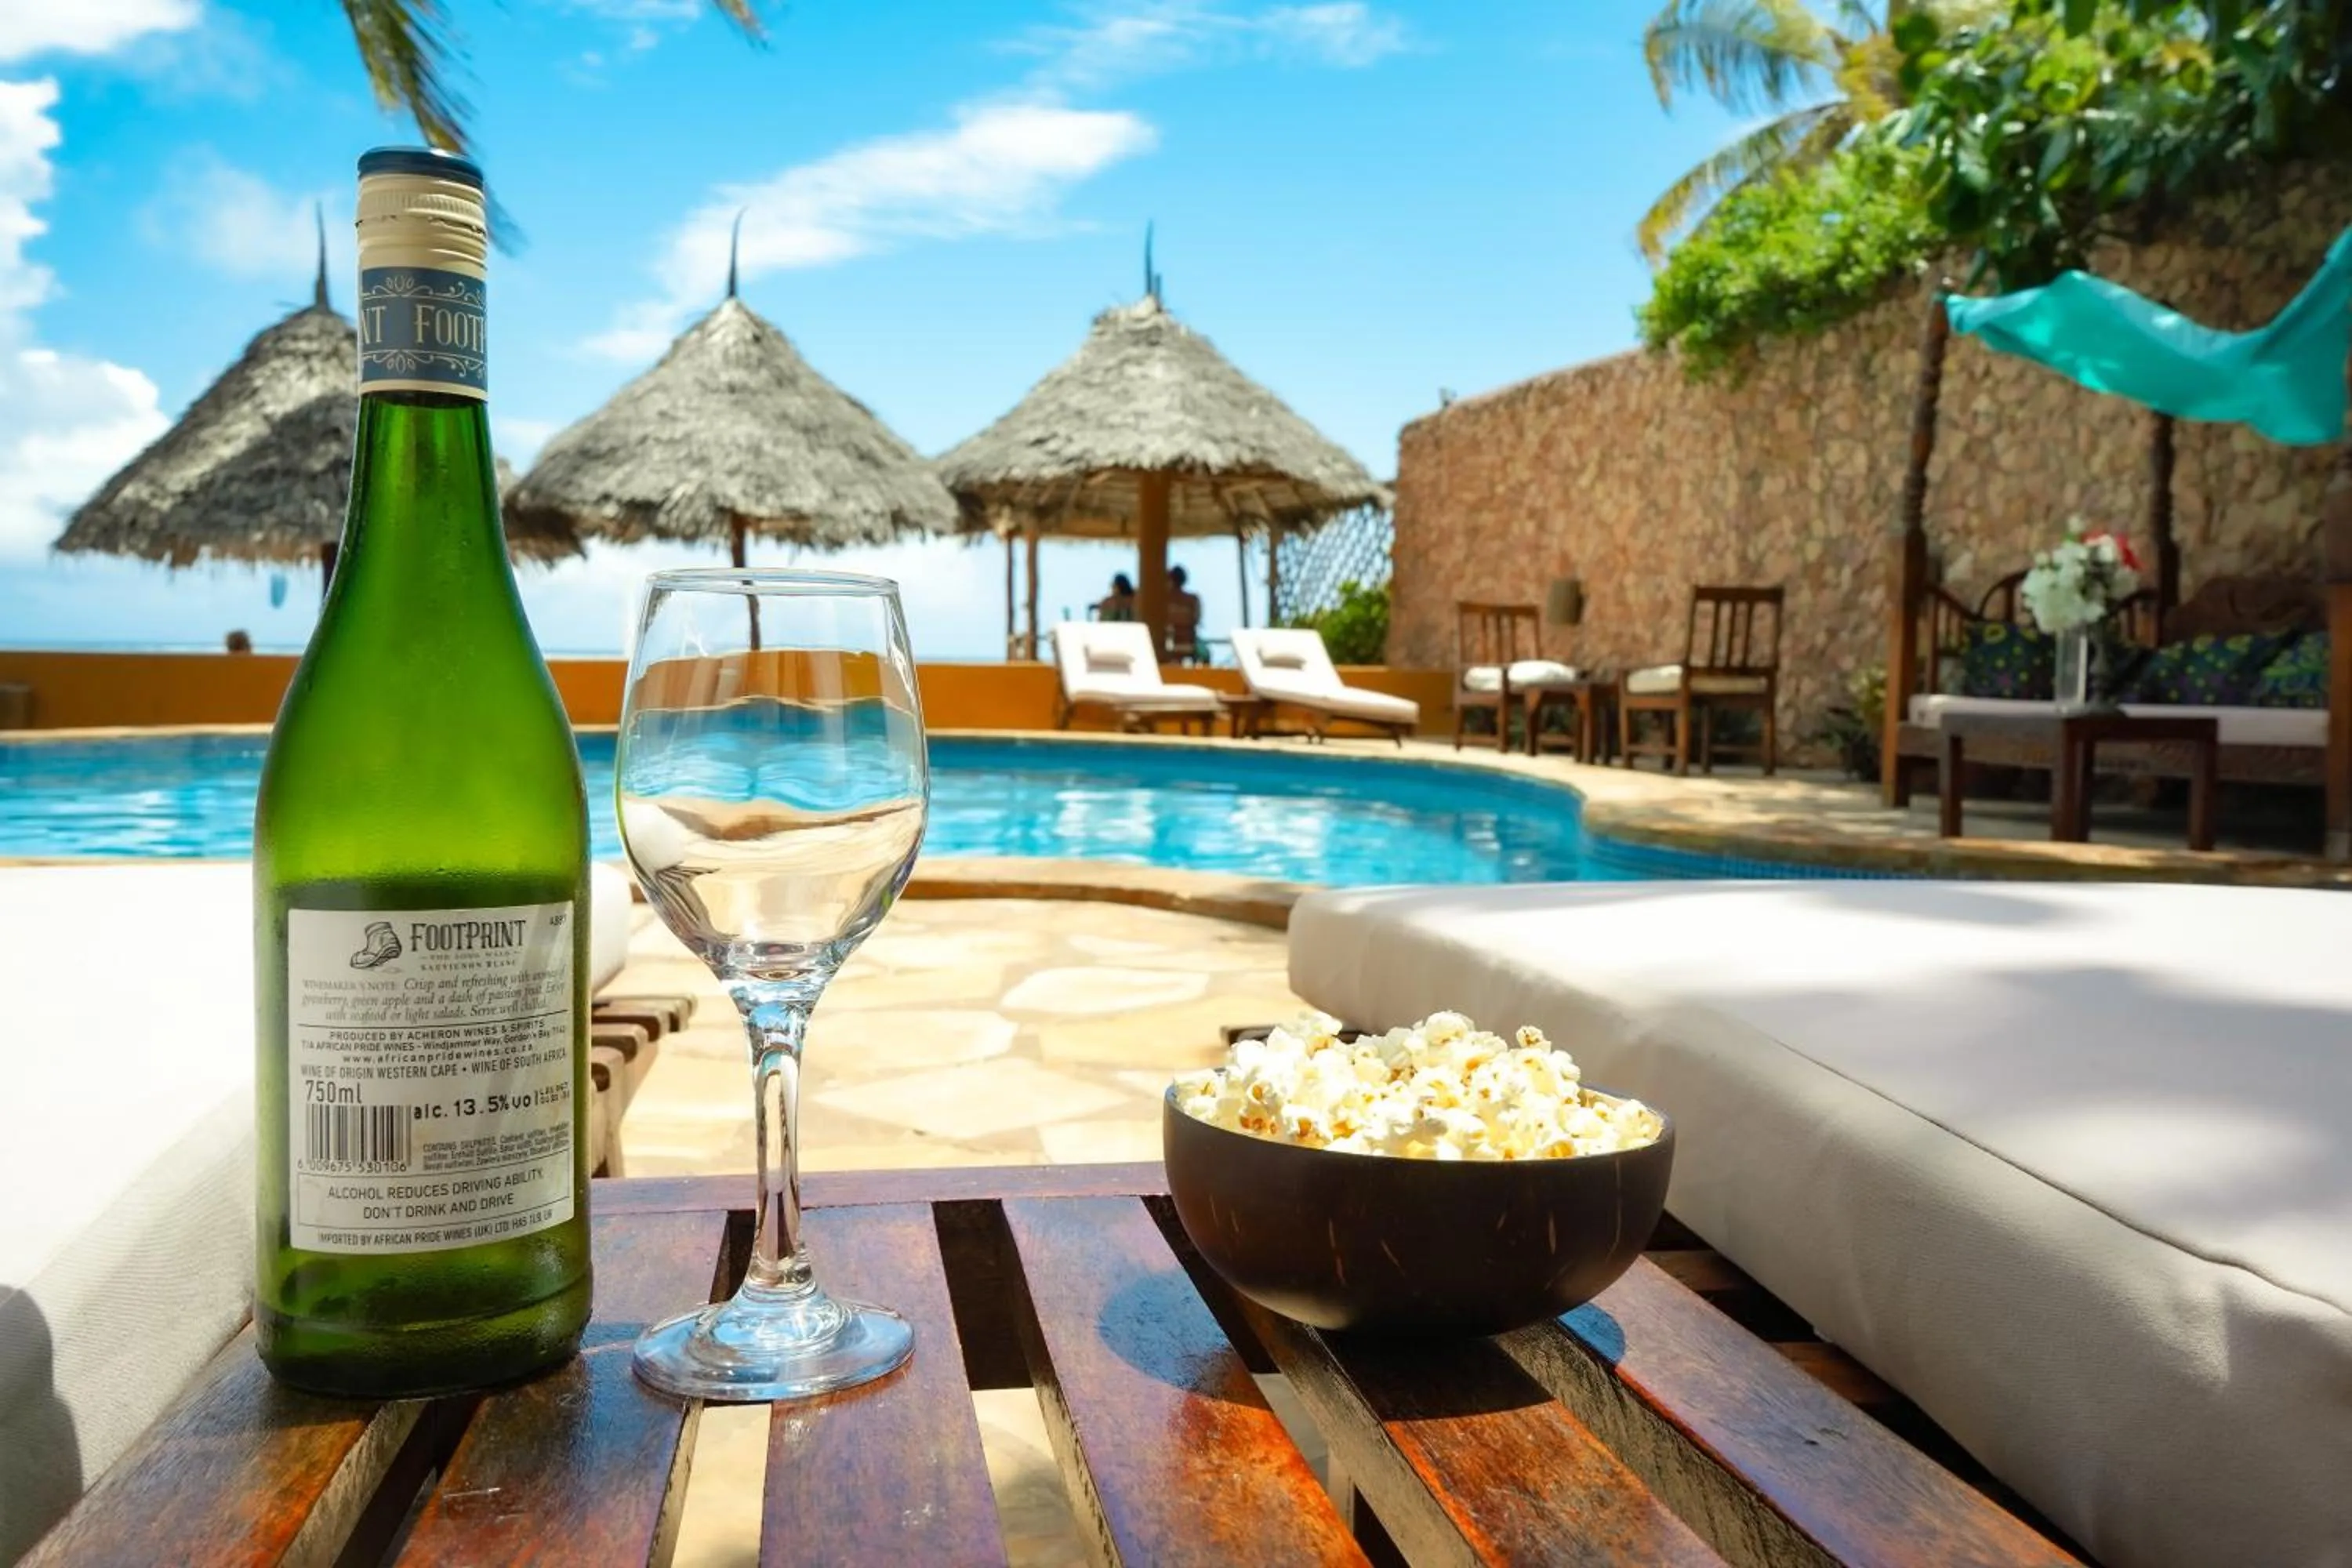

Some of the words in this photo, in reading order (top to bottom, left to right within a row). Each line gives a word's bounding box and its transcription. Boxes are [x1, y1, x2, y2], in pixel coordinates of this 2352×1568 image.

[410, 920, 526, 952] FOOTPRINT
[420, 962, 482, 971] SAUVIGNON
[404, 978, 434, 993] Crisp
[437, 975, 459, 989] and
[462, 973, 509, 990] refreshing
[510, 970, 530, 983] with
[351, 997, 379, 1009] green
[382, 993, 410, 1008] apple
[413, 992, 435, 1004] and
[437, 995, 446, 1004] a
[448, 988, 473, 1004] dash
[475, 987, 488, 1005] of
[325, 1010, 347, 1022] with
[390, 1011, 402, 1020] or
[405, 1007, 429, 1025] light
[470, 1004, 498, 1017] Serve
[499, 1000, 518, 1014] well
[329, 1031, 387, 1041] PRODUCED
[390, 1030, 404, 1041] BY
[407, 1029, 460, 1040] ACHERON
[464, 1025, 498, 1036] WINES
[501, 1025, 507, 1033] &
[510, 1019, 545, 1033] SPIRITS
[316, 1041, 352, 1051] AFRICAN
[354, 1042, 380, 1051] PRIDE
[383, 1042, 415, 1051] WINES
[423, 1039, 481, 1051] Windjammer
[342, 1044, 533, 1064] www.africanpridewines.co.za
[300, 1064, 322, 1077] WINE
[324, 1065, 337, 1078] OF
[339, 1065, 374, 1079] ORIGIN
[377, 1065, 427, 1079] WESTERN
[430, 1064, 458, 1078] CAPE
[471, 1060, 499, 1073] WINE
[499, 1058, 512, 1071] OF
[514, 1053, 542, 1069] SOUTH
[543, 1047, 566, 1062] AFRICA
[305, 1080, 362, 1104] 750ml
[413, 1103, 448, 1120] alc.
[297, 1159, 303, 1169] 6
[358, 1161, 407, 1173] 530106
[328, 1185, 384, 1200] ALCOHOL
[387, 1183, 449, 1200] REDUCES
[452, 1177, 502, 1195] DRIVING
[363, 1206, 402, 1219] DON'T
[405, 1203, 446, 1218] DRINK
[450, 1200, 477, 1214] AND
[480, 1193, 514, 1210] DRIVE
[318, 1232, 358, 1245] IMPORTED
[361, 1233, 372, 1246] BY
[374, 1232, 412, 1246] AFRICAN
[415, 1229, 441, 1244] PRIDE
[443, 1227, 472, 1241] WINES
[474, 1223, 493, 1238] (UK)
